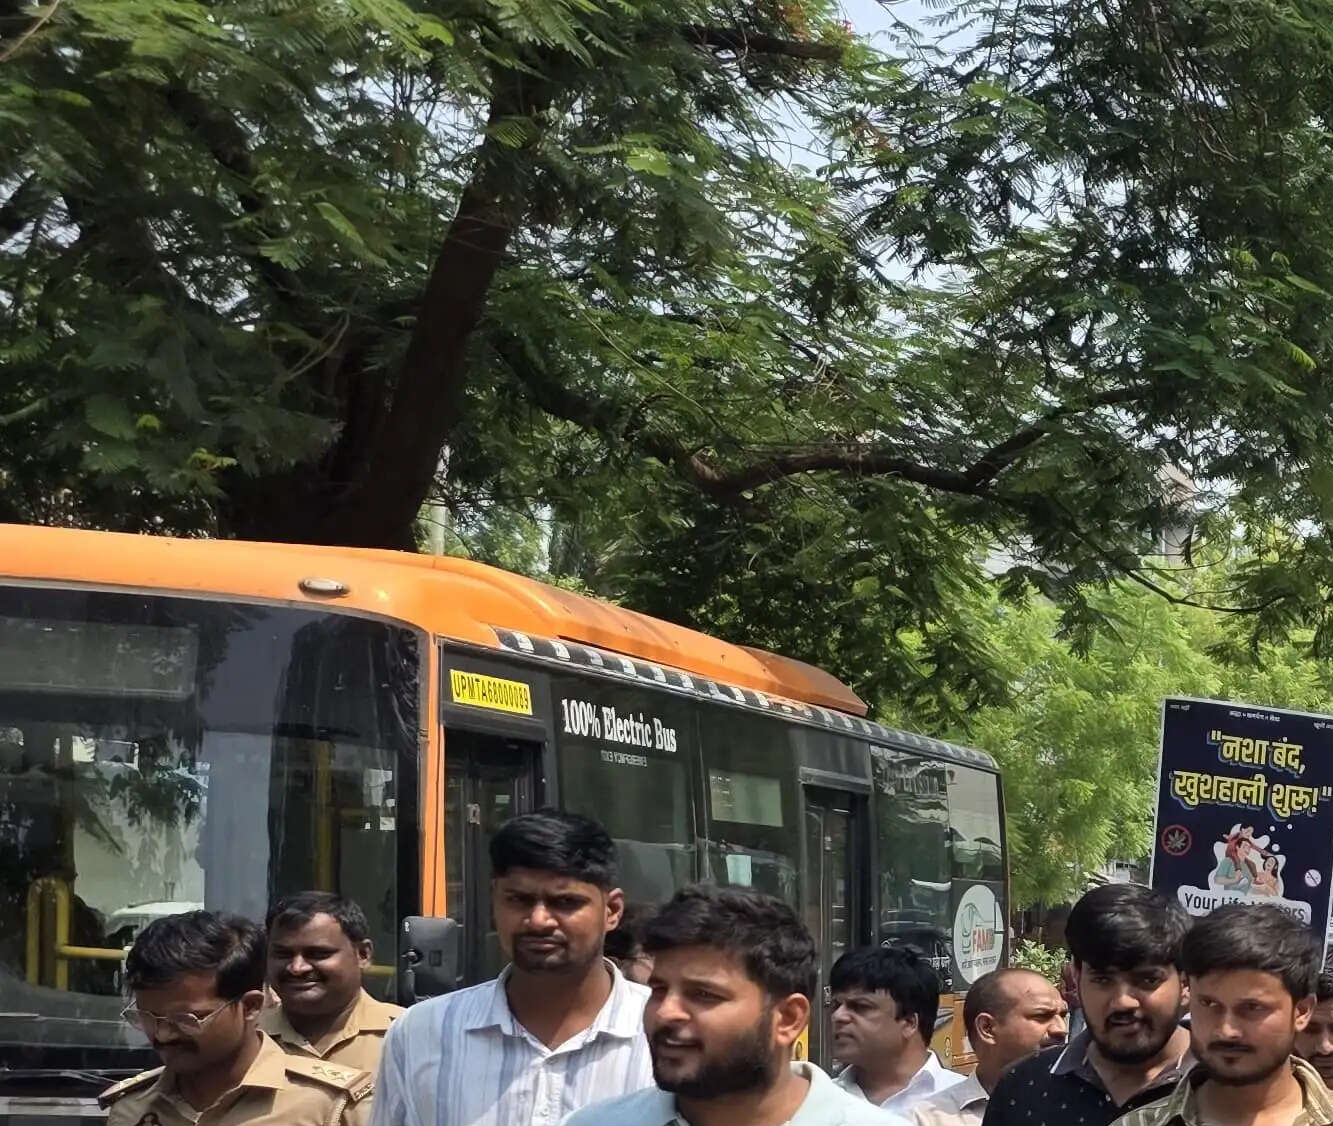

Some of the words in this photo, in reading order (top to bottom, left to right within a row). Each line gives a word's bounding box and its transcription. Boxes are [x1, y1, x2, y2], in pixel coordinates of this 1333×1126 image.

[562, 698, 600, 738] 100%
[602, 706, 652, 748] Electric
[653, 717, 677, 752] Bus
[1211, 730, 1269, 765] "नशा
[1272, 737, 1306, 774] बंद,
[1173, 770, 1268, 807] खुशहाली
[1185, 892, 1217, 911] Your
